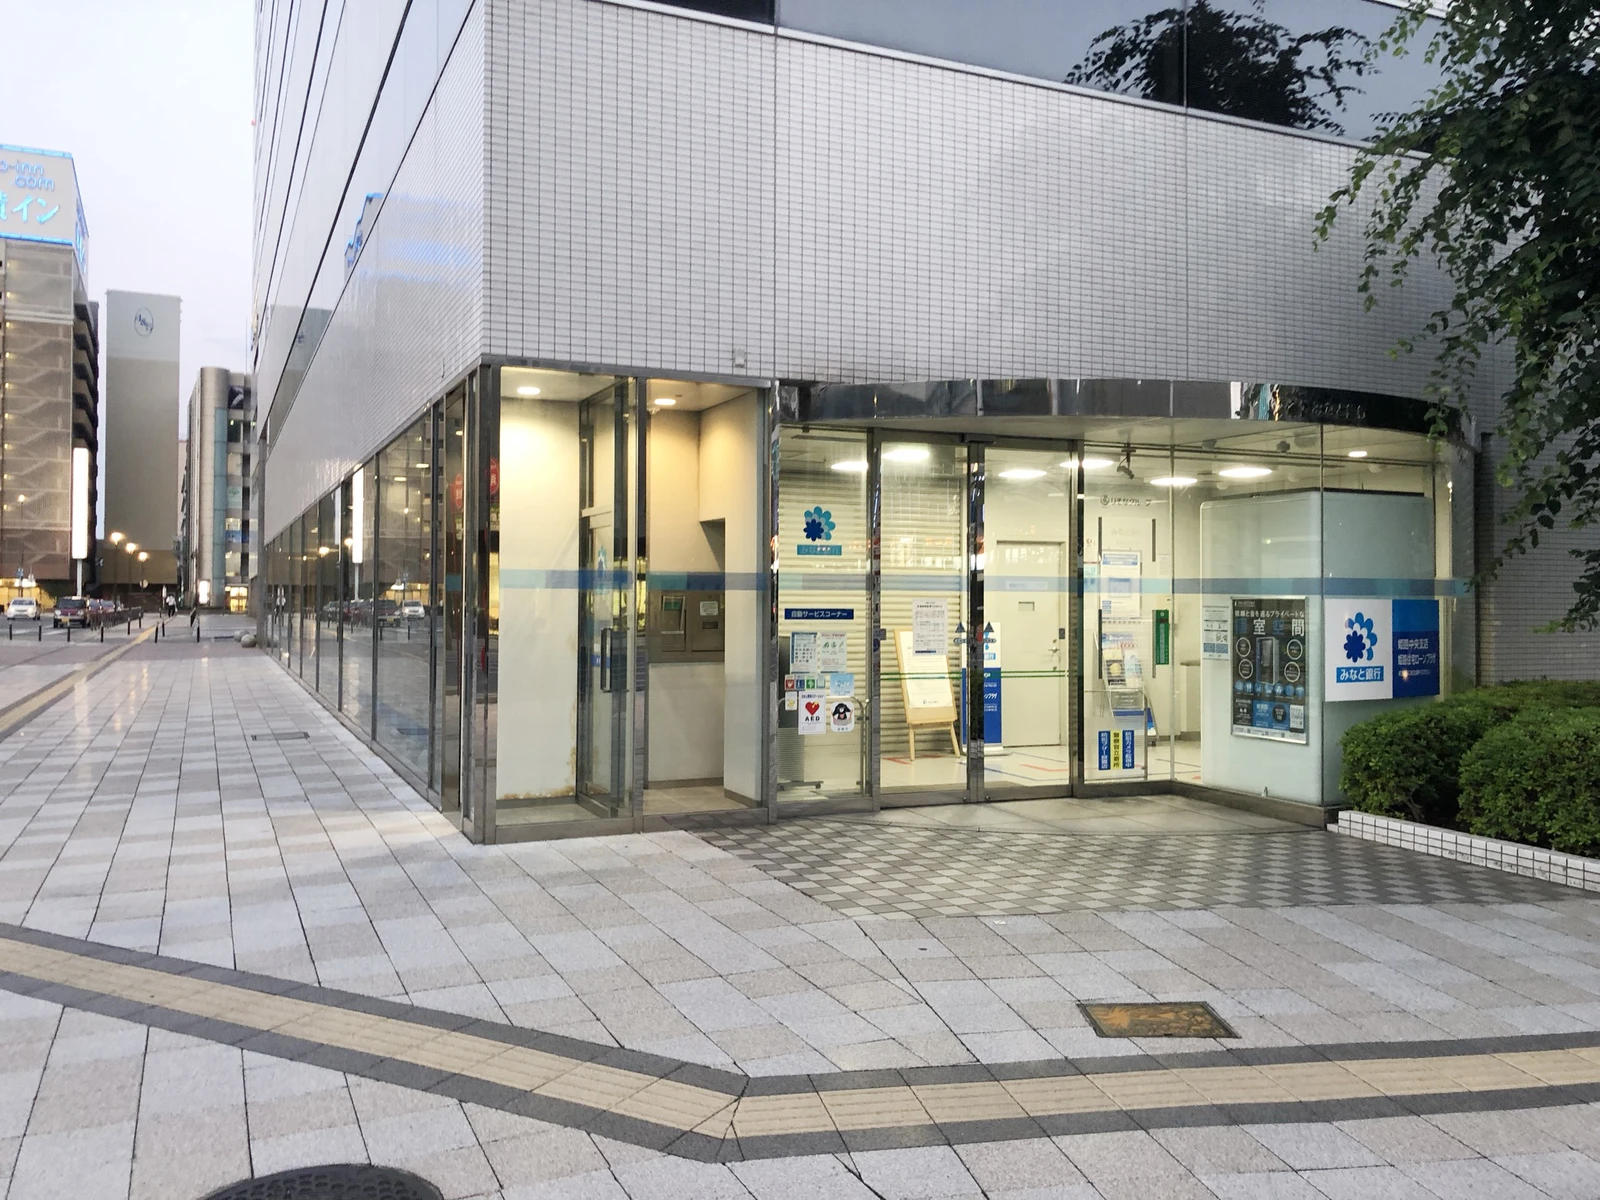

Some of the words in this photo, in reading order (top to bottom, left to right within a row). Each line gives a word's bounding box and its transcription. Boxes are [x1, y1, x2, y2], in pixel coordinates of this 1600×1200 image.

[791, 610, 848, 618] 自動サービスコーナー
[1340, 667, 1381, 681] みなと銀行
